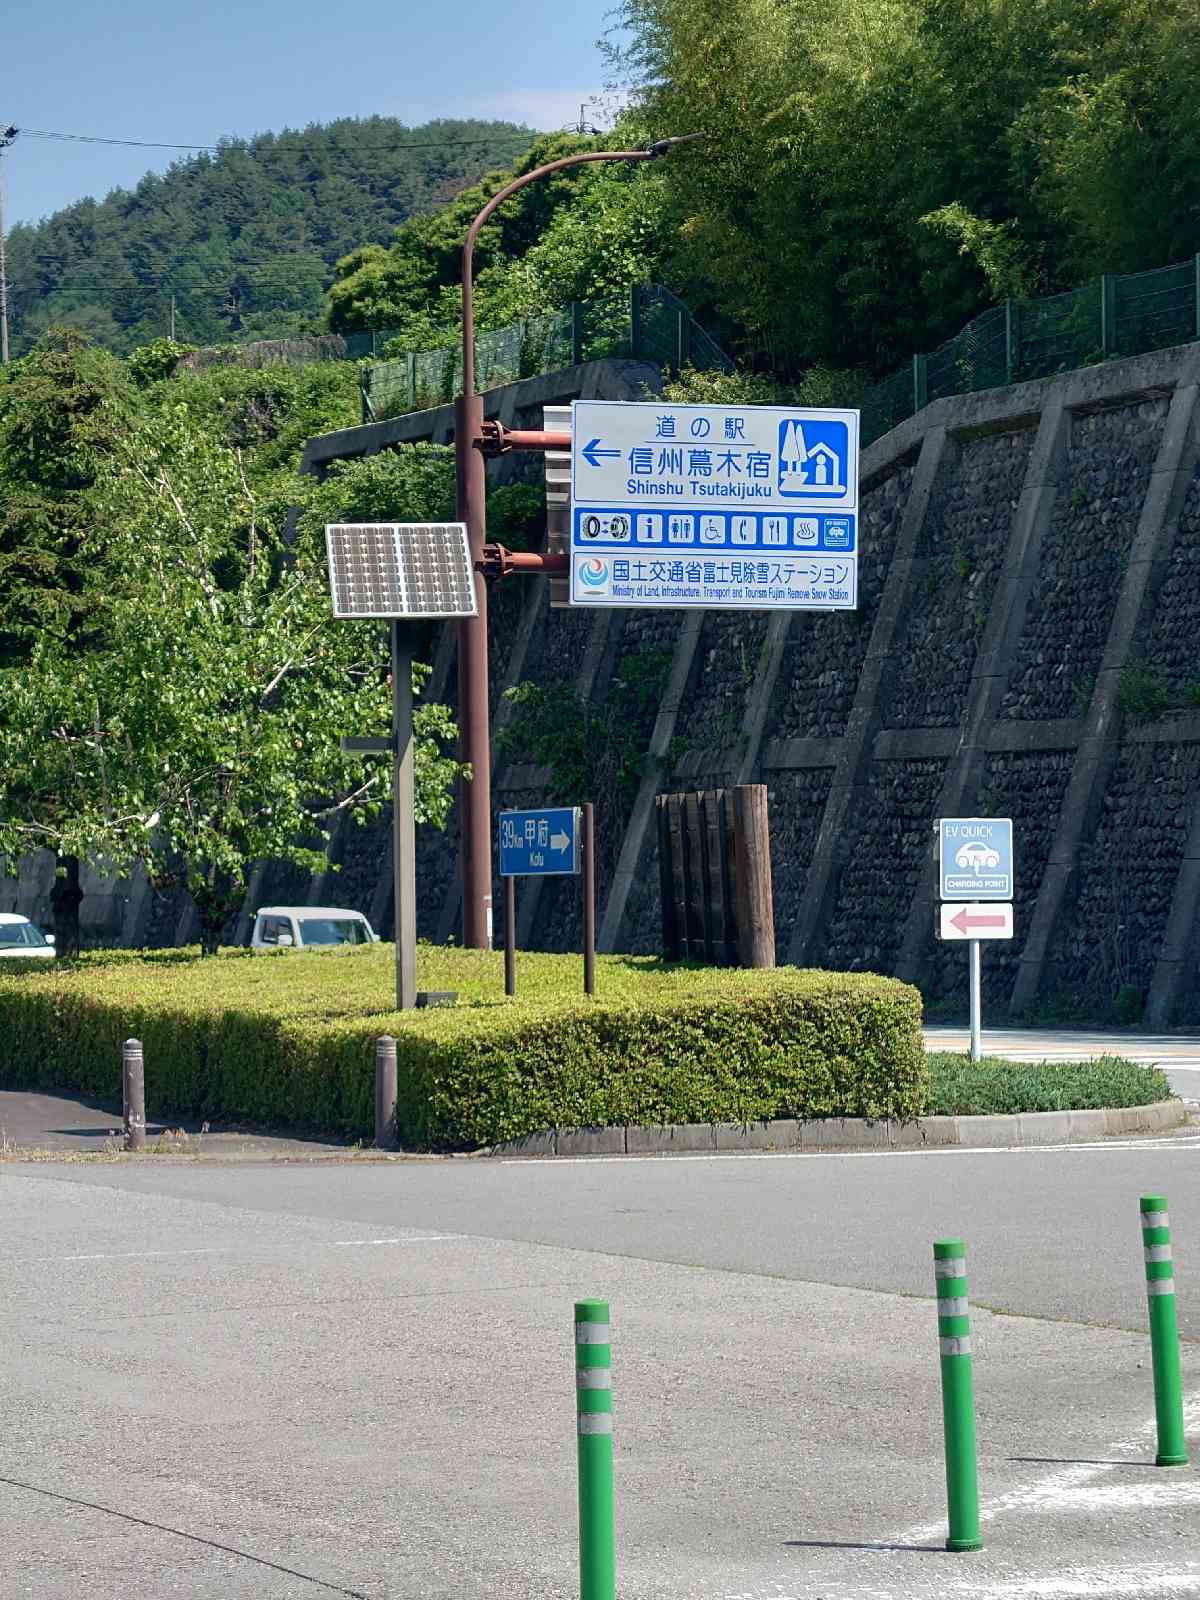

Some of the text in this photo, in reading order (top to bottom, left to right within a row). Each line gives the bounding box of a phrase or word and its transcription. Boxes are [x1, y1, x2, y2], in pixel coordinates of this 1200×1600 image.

[655, 414, 746, 440] 道の駅
[628, 447, 772, 478] 信州蔦木宿
[627, 479, 772, 500] Shinshu Tsutakijuku
[613, 560, 849, 584] 国土交通省富士見除雪ステーション
[612, 584, 634, 598] Ministry
[635, 585, 643, 597] of
[703, 587, 731, 600] Transport
[732, 587, 743, 599] and
[745, 587, 768, 599] Tourism
[787, 588, 810, 600] Remove
[811, 588, 826, 600] Snow
[828, 588, 849, 601] Station
[524, 818, 549, 848] 甲府
[945, 825, 992, 839] EV QUICK
[948, 879, 1005, 889] CHARGING POINT
